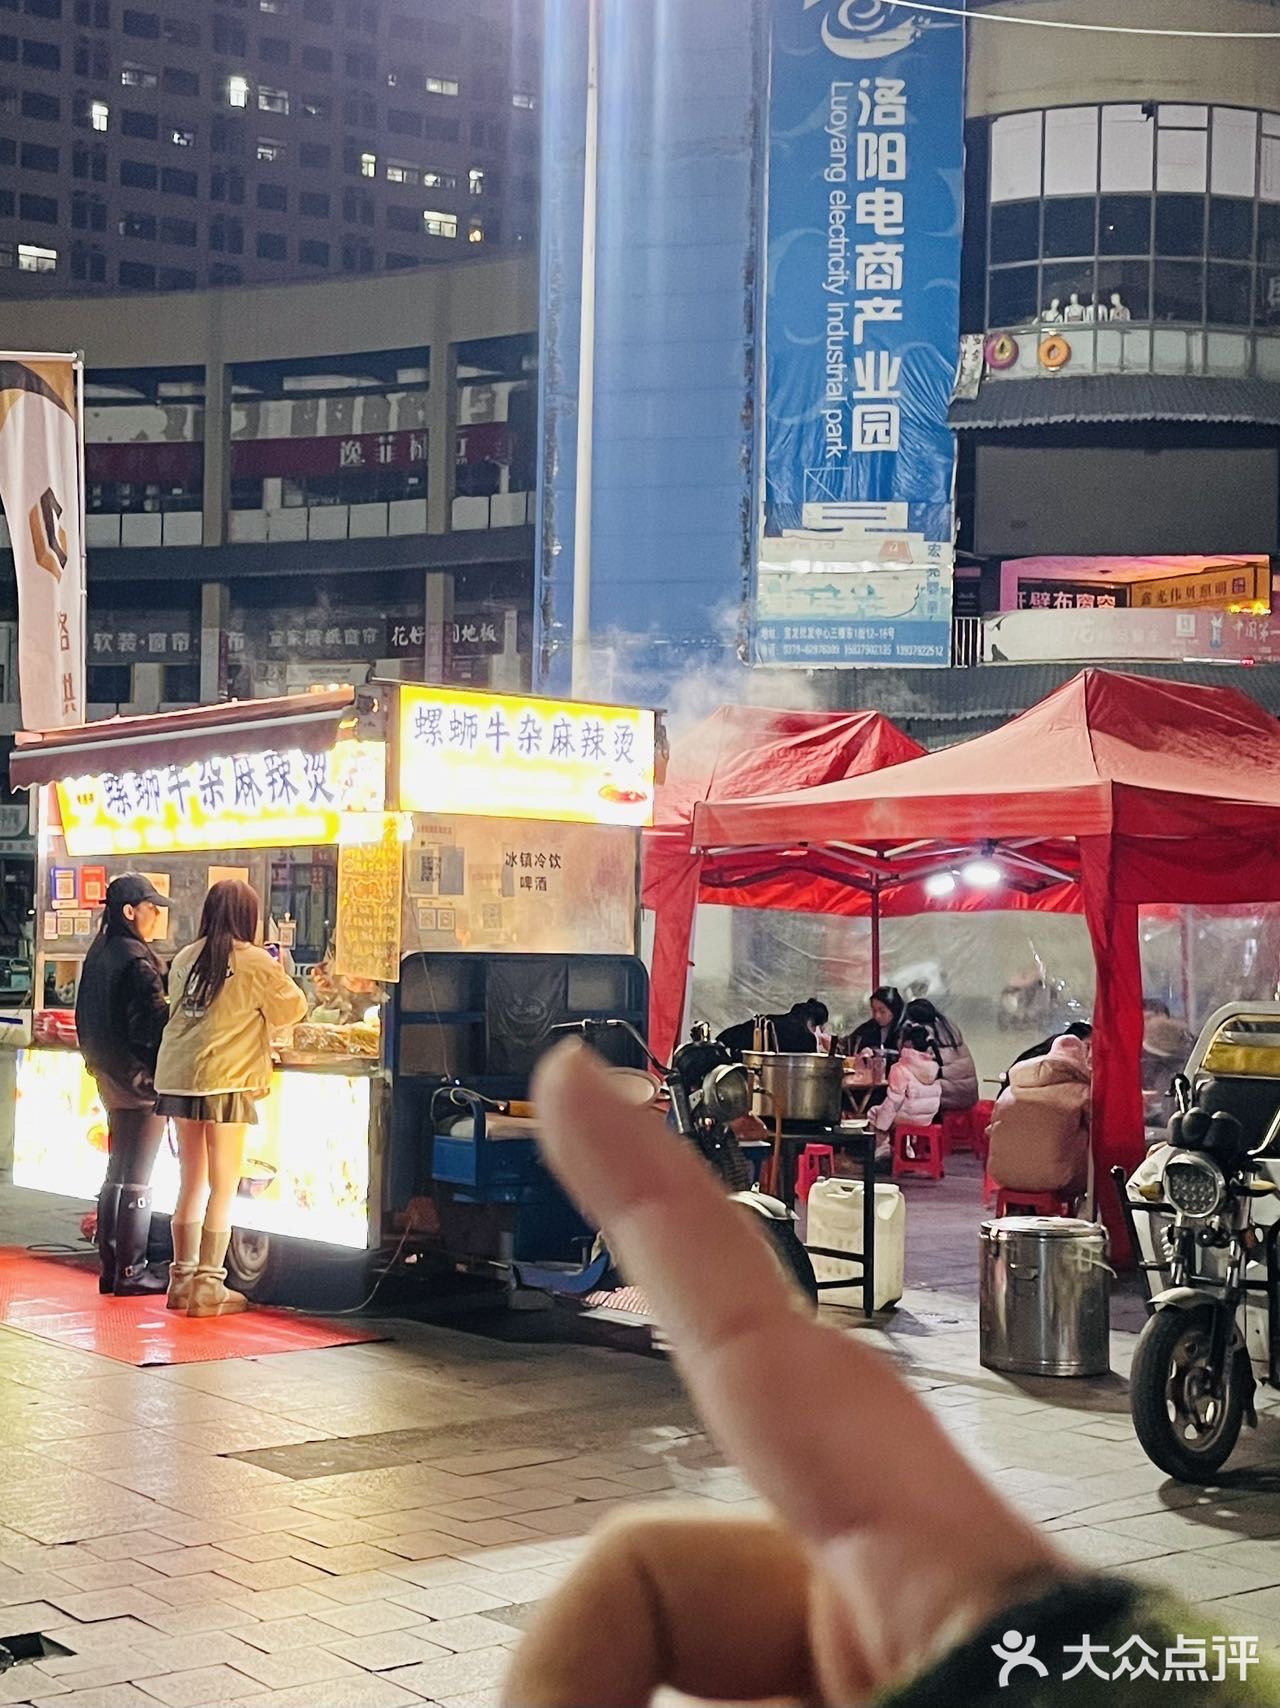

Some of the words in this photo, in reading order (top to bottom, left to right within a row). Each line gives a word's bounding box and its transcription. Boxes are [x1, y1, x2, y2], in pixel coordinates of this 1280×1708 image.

[824, 81, 854, 183] Luoyang
[822, 189, 851, 296] electricity
[852, 77, 906, 452] 洛阳电商产业园
[824, 302, 850, 402] Industrial
[824, 408, 848, 459] park
[391, 623, 497, 647] 花好地板
[414, 706, 635, 765] 螺蛳牛杂麻辣烫
[505, 851, 563, 870] 冰镇冷饮
[519, 875, 548, 892] 啤酒
